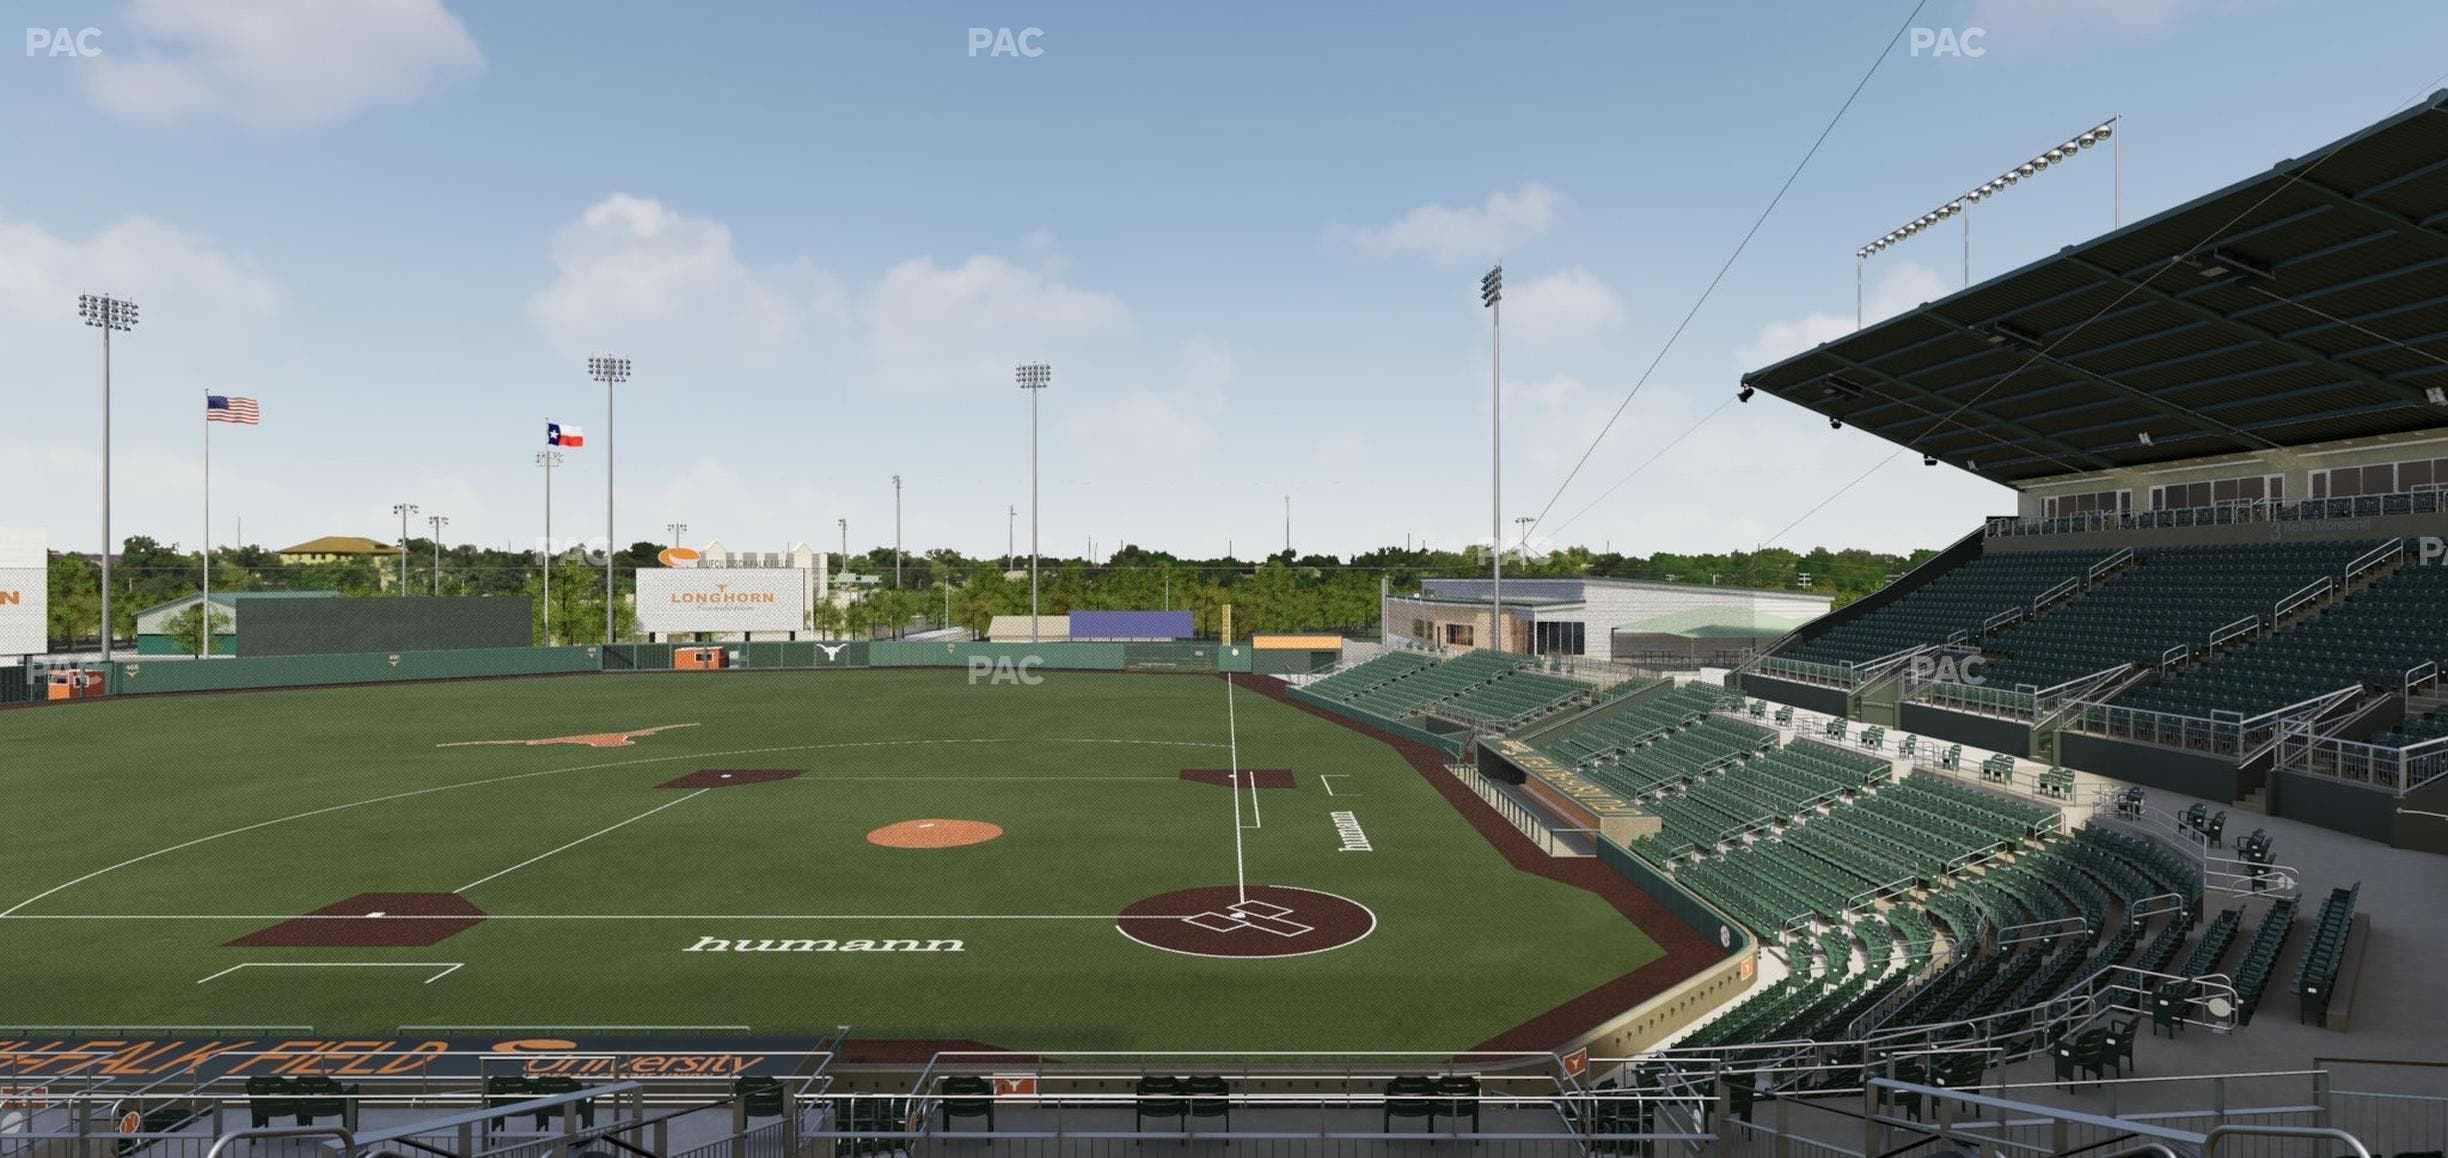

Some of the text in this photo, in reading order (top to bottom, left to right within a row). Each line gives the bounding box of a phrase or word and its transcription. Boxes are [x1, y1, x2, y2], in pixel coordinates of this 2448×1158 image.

[670, 592, 775, 603] LONGHORN
[682, 936, 965, 951] humann
[225, 1041, 448, 1075] FIELD
